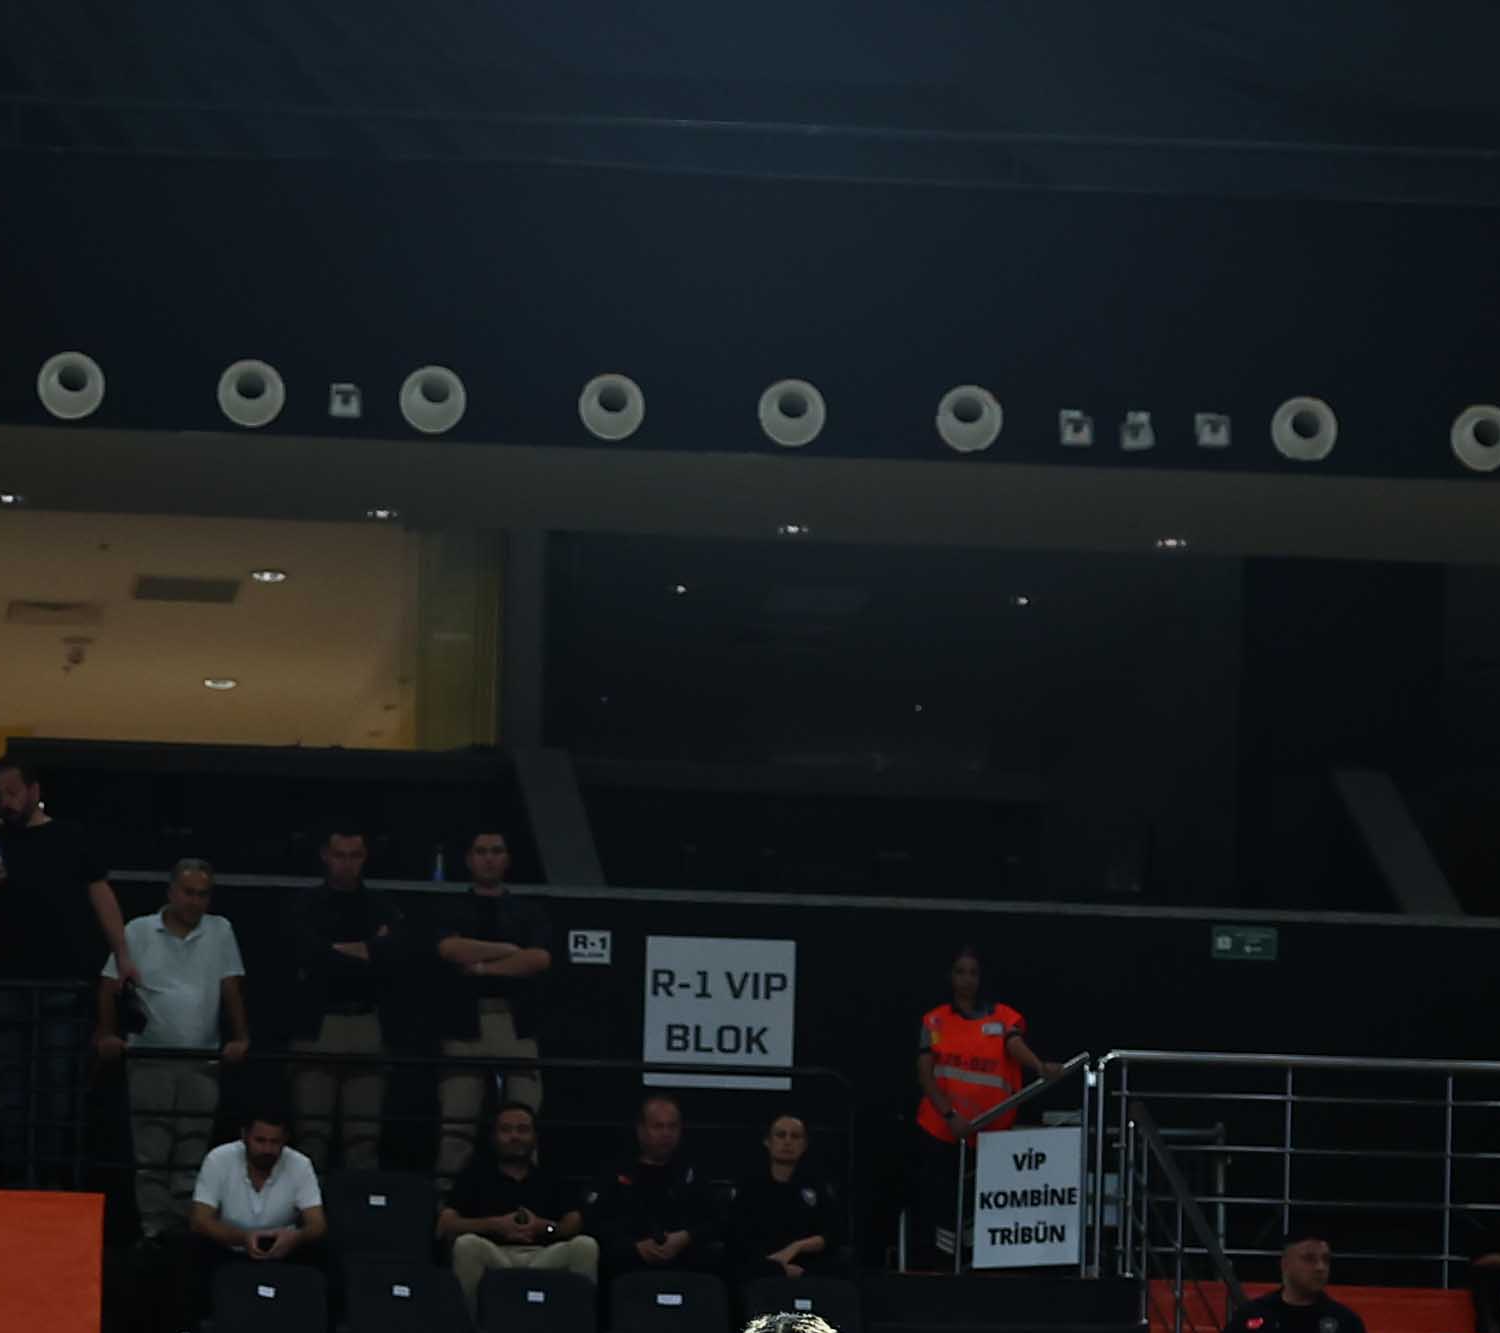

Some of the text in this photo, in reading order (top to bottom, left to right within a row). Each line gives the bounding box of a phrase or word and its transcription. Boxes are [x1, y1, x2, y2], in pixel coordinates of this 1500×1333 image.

[573, 934, 607, 950] R-1
[652, 969, 788, 1000] R-1 VIP
[666, 1023, 769, 1055] BLOK
[980, 1184, 1079, 1210] KOMBİNE
[988, 1221, 1066, 1247] TRİBÜN
